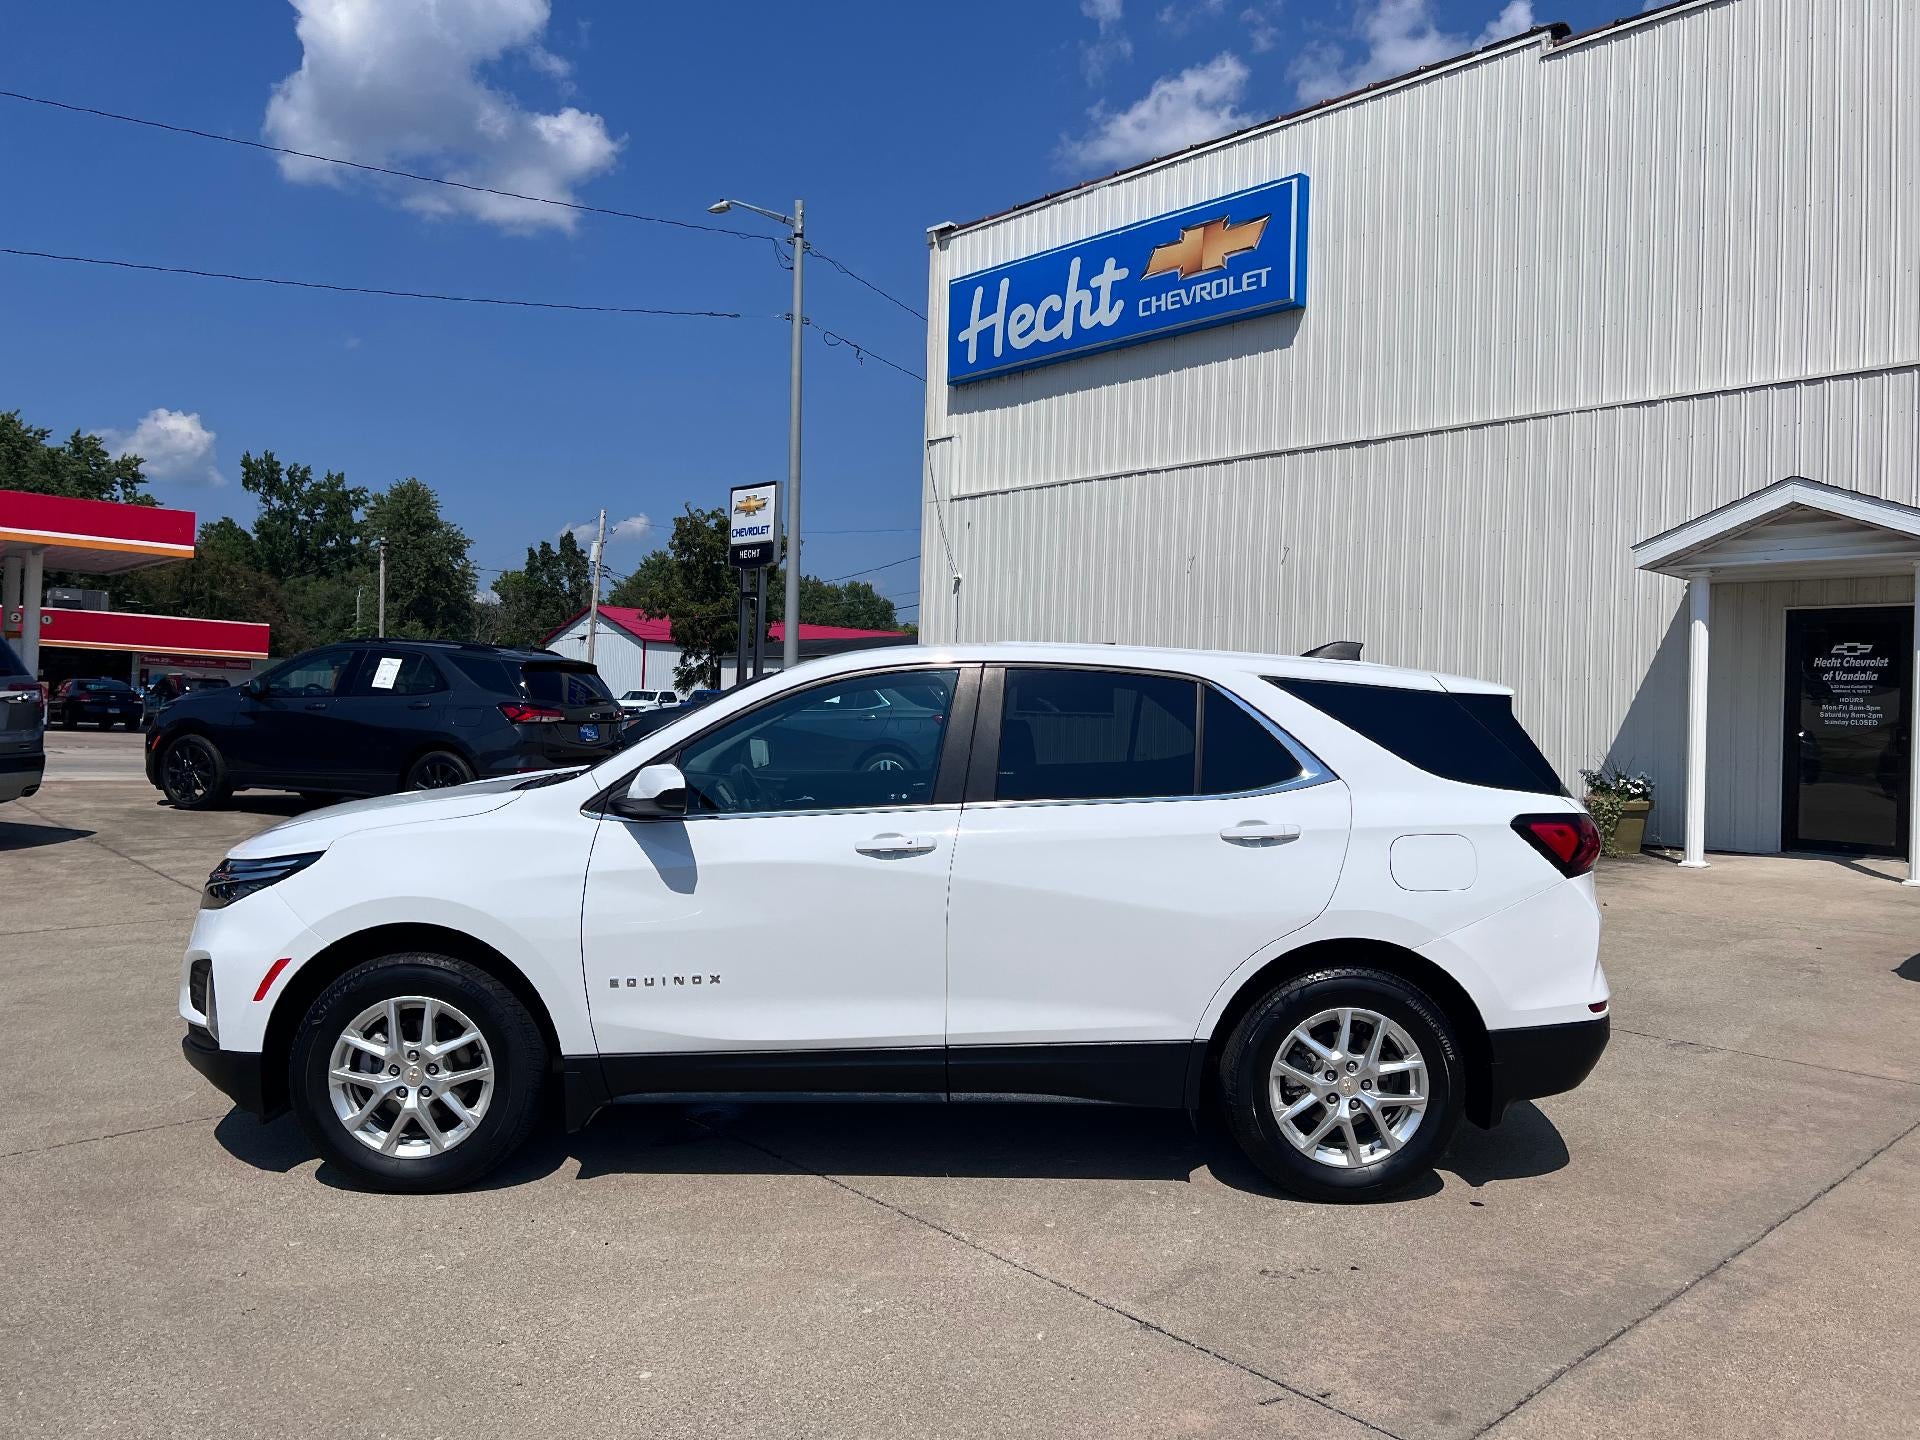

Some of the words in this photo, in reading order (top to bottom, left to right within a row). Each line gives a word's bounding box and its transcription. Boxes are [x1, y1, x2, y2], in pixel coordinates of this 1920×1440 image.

[1138, 266, 1272, 317] CHEVROLET
[958, 256, 1129, 363] Hecht
[732, 525, 770, 538] CHEVROLET
[740, 549, 760, 559] HECHT
[1813, 657, 1841, 667] Hecht
[1843, 657, 1889, 667] Chevrolet
[1822, 671, 1834, 681] of
[1835, 671, 1879, 681] Vandalia
[1819, 711, 1850, 719] Saturday
[1824, 719, 1849, 727] Sunday
[609, 974, 721, 988] EQUINOX
